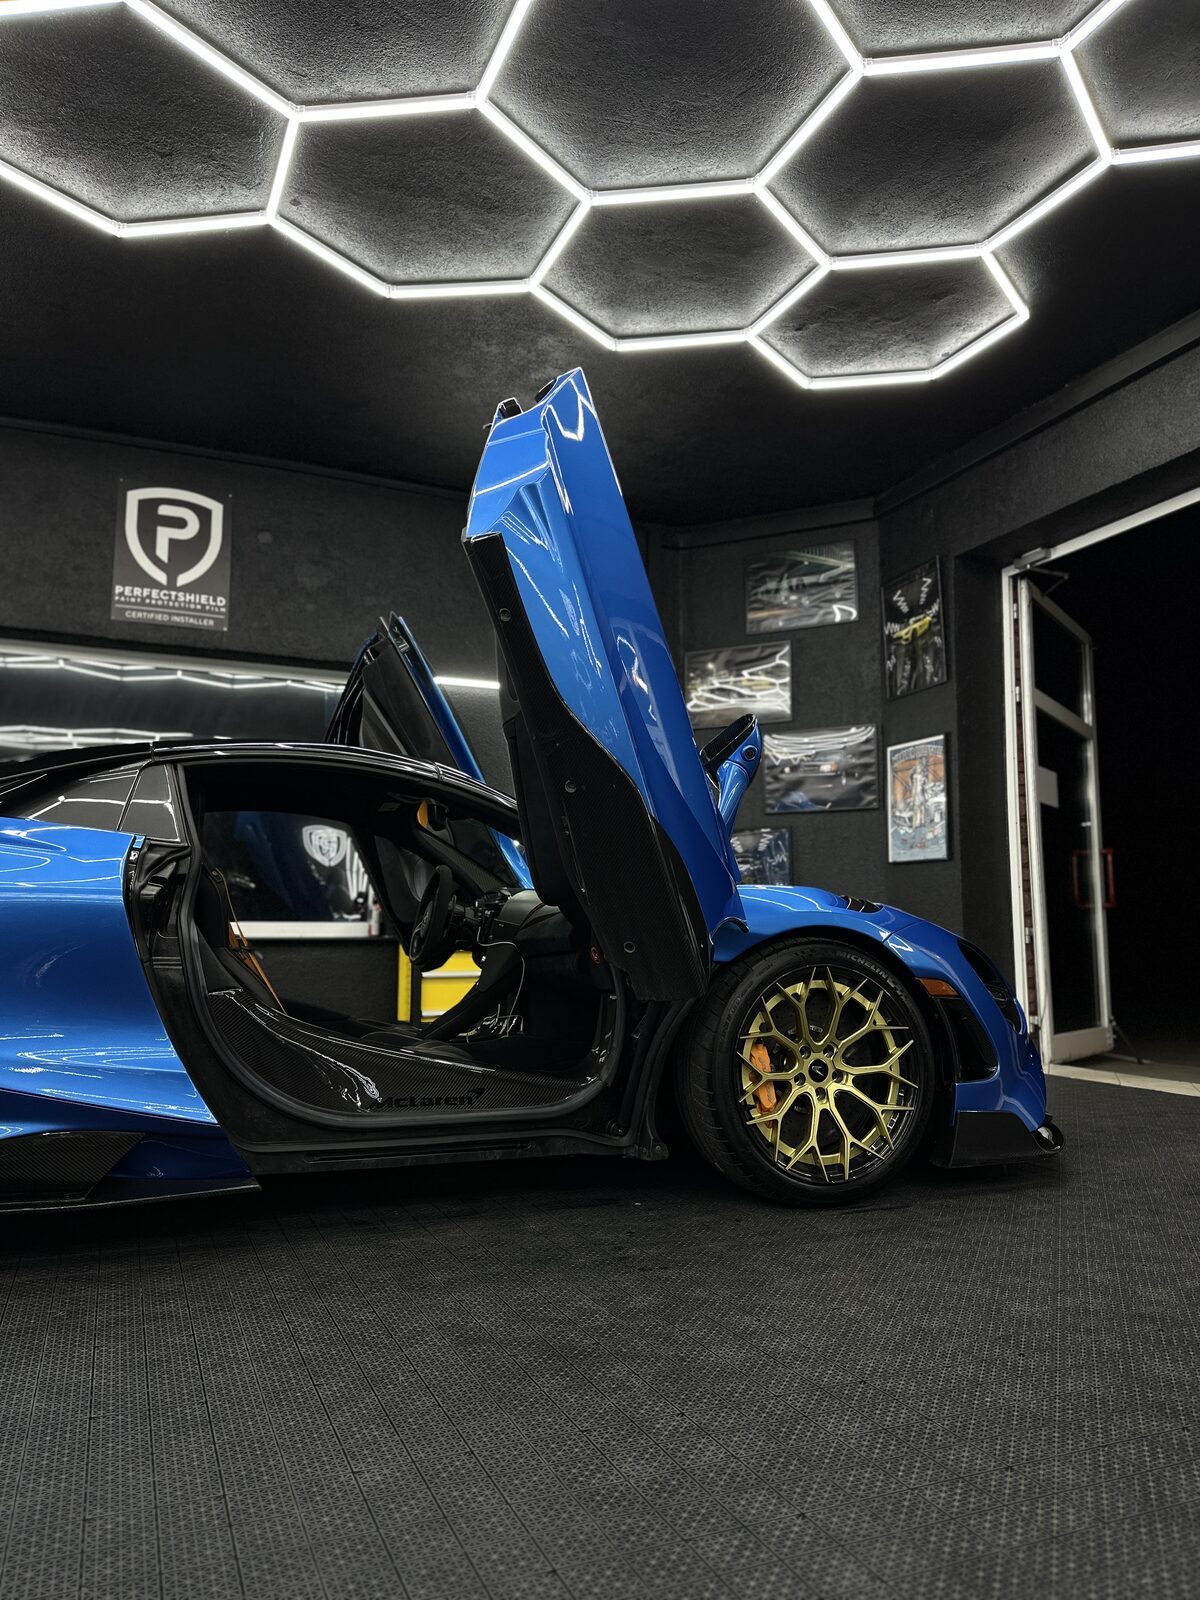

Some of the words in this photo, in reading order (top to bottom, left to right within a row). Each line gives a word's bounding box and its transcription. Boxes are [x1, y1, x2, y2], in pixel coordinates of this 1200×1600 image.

[115, 585, 226, 606] PERFECTSHIELD
[145, 599, 202, 610] PROTECTION
[205, 605, 226, 613] FILM
[125, 610, 169, 621] CERTIFIED
[171, 615, 214, 626] INSTALLER
[836, 950, 889, 980] MICHELIN
[375, 1096, 474, 1108] McLaren
